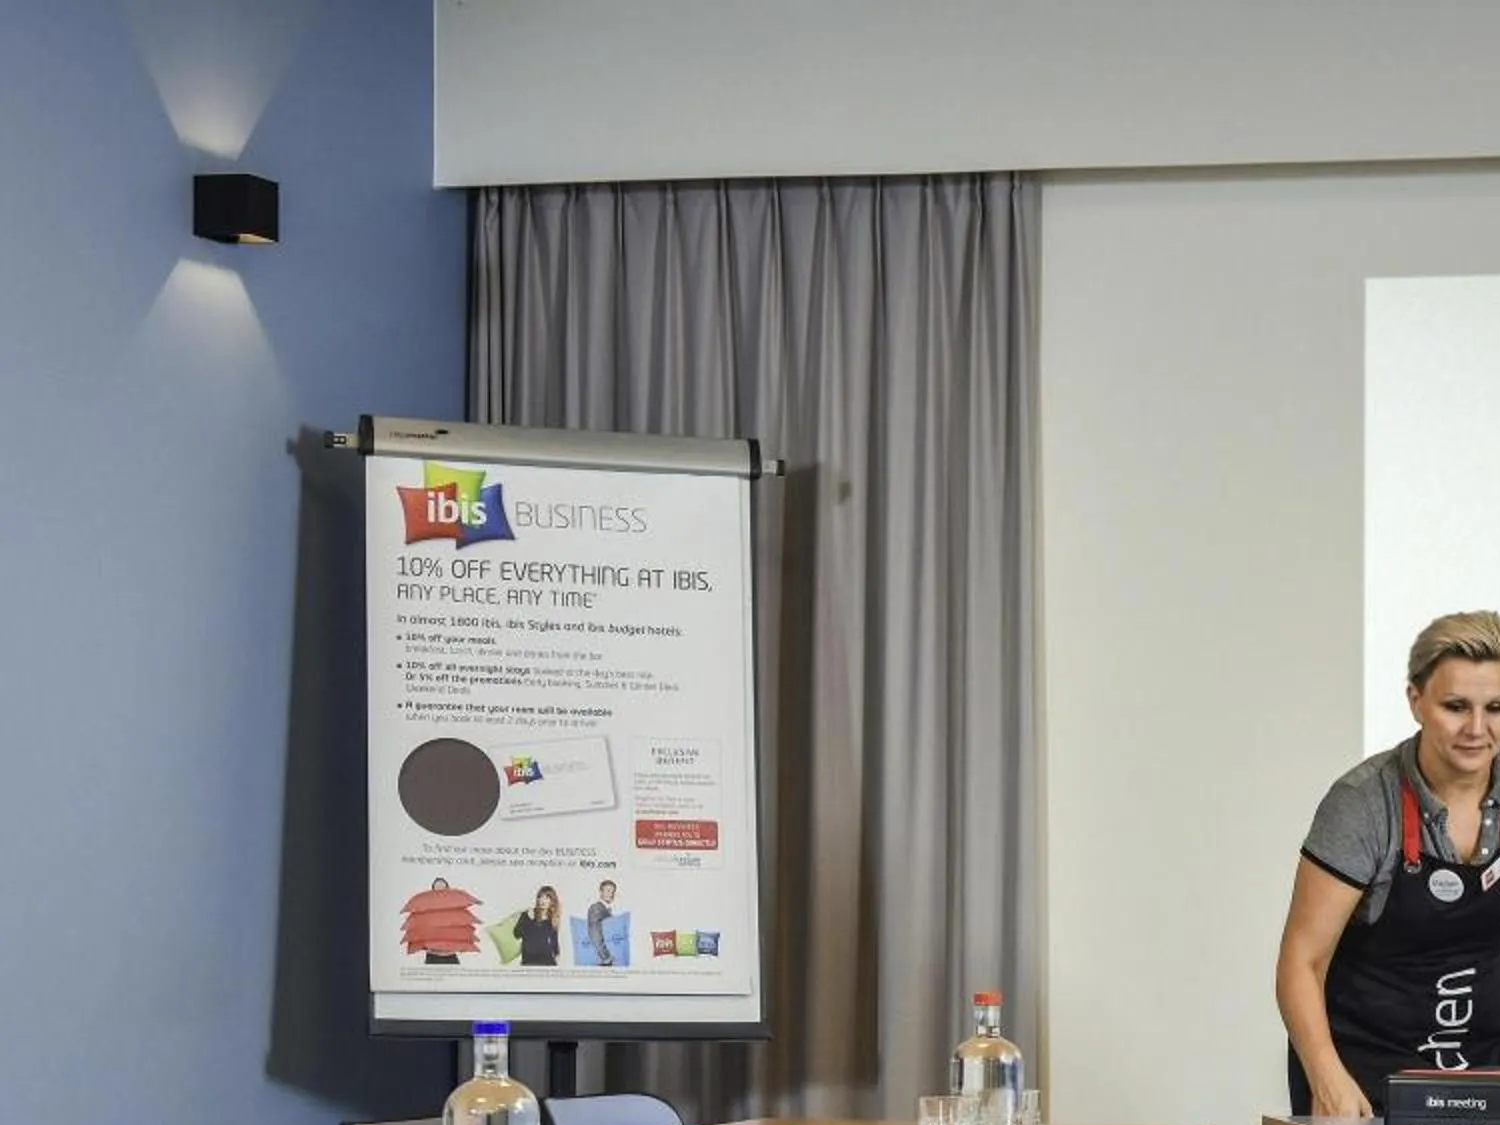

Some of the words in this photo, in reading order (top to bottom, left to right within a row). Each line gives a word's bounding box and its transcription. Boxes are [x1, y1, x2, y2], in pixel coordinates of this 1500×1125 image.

[427, 491, 487, 525] ibis
[515, 501, 648, 533] BUSINESS
[397, 557, 443, 578] 10%
[451, 559, 492, 579] OFF
[501, 561, 630, 587] EVERYTHING
[637, 568, 664, 589] AT
[673, 570, 713, 592] IBIS,
[397, 583, 433, 601] ANY
[440, 586, 500, 605] PLACE,
[507, 589, 543, 606] ANY
[410, 615, 446, 625] almost
[528, 620, 561, 632] Styles
[564, 622, 585, 631] and
[608, 624, 645, 636] budget
[428, 634, 442, 642] off
[415, 703, 464, 712] guarantee
[465, 703, 485, 712] that
[487, 705, 510, 715] your
[569, 707, 613, 717] available
[1426, 1096, 1445, 1108] ibis
[1447, 1097, 1487, 1111] meeting
